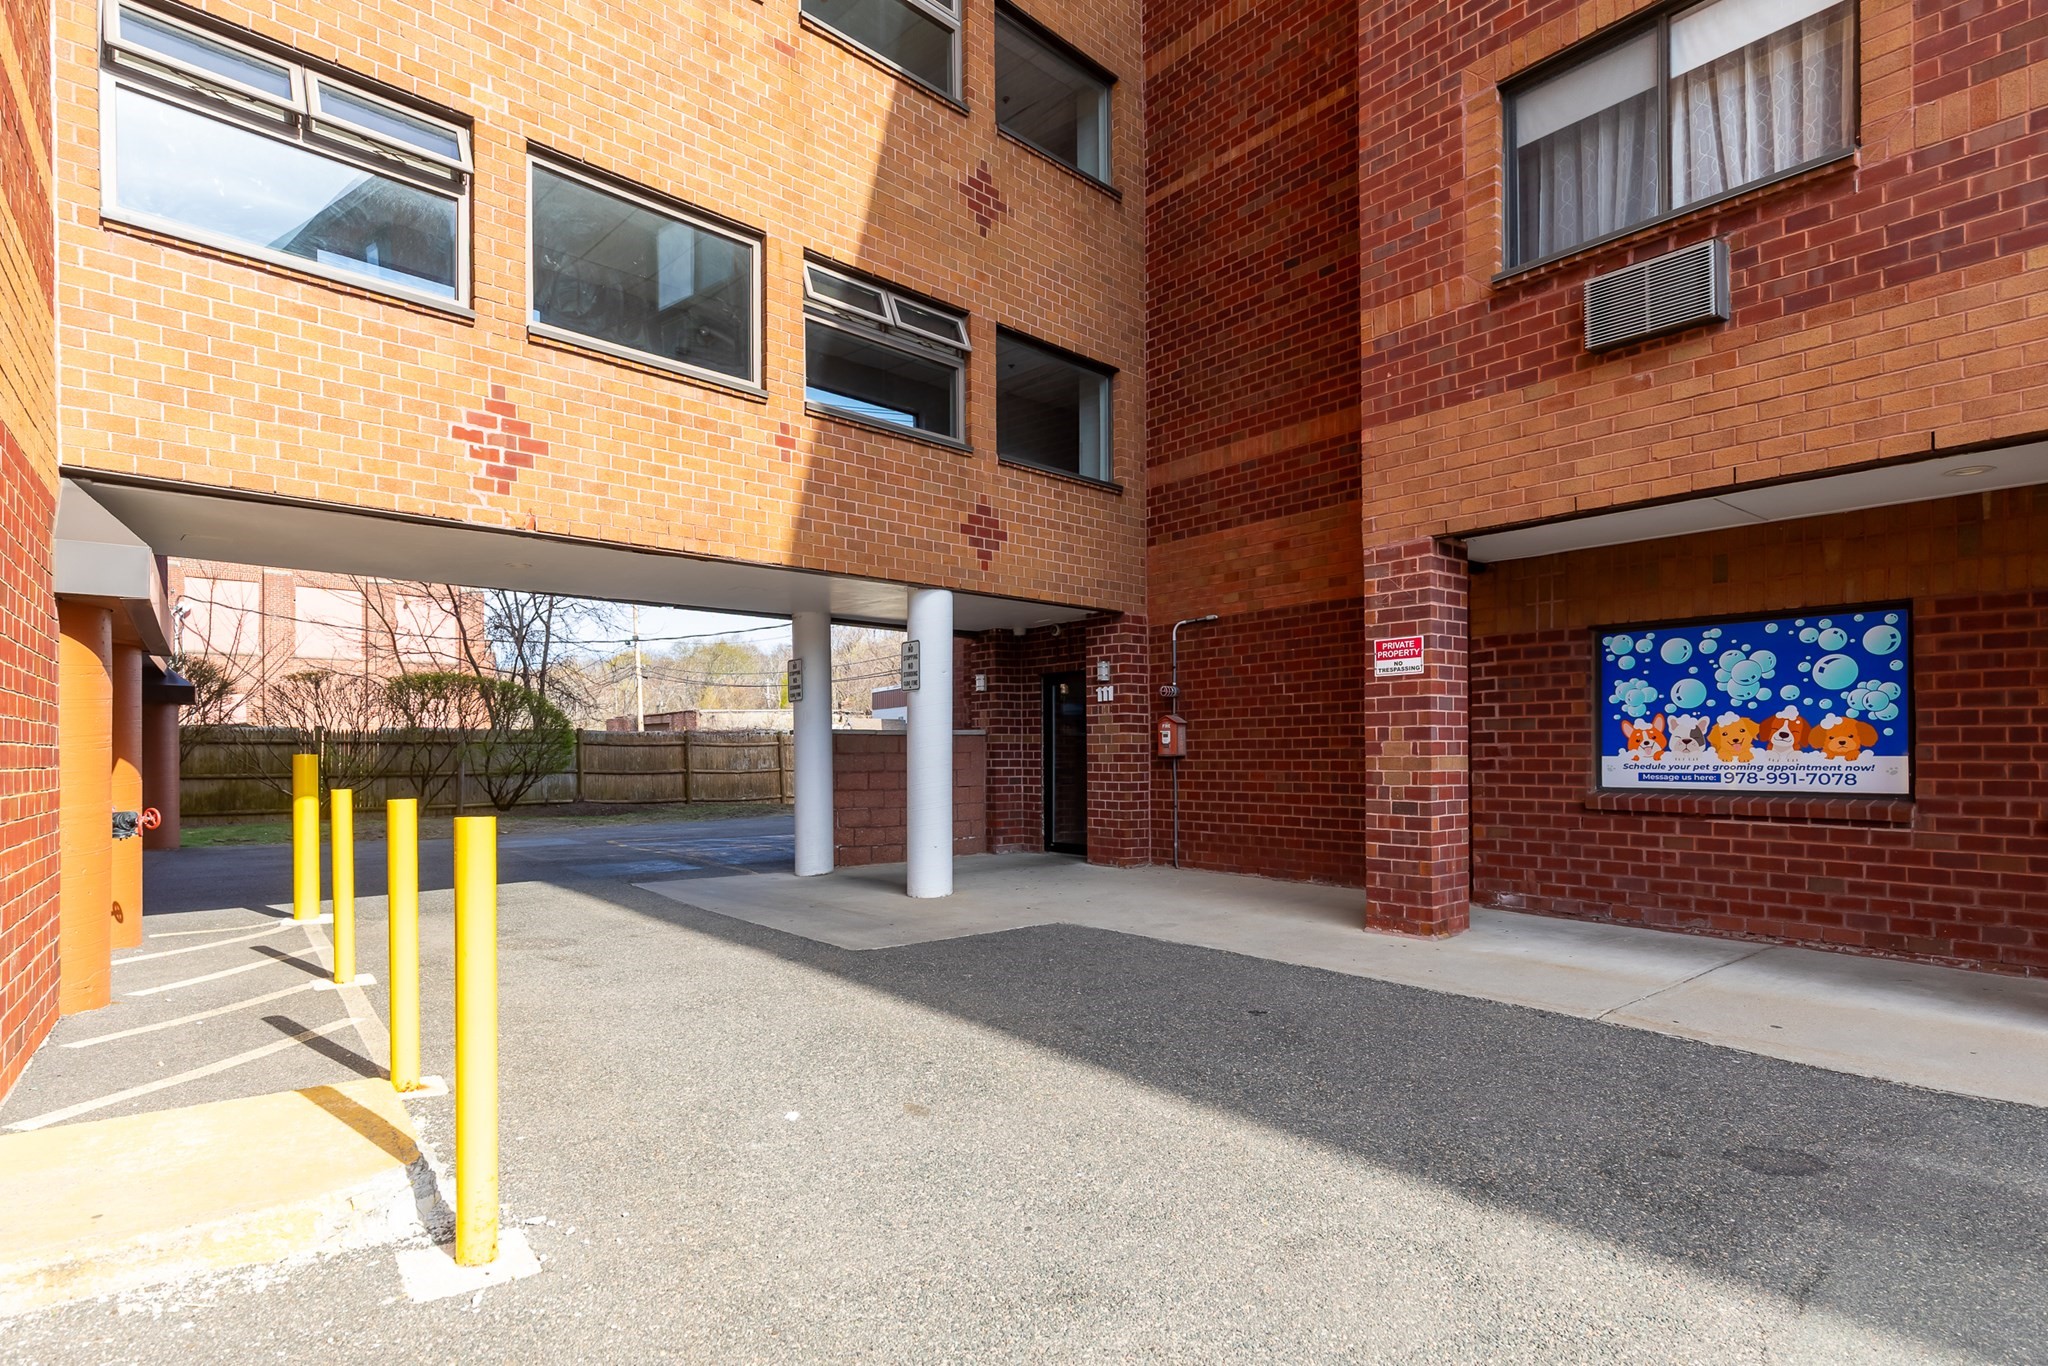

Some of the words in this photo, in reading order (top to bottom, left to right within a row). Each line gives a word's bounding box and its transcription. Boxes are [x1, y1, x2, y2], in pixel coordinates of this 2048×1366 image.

[1382, 640, 1415, 650] PRIVATE
[1378, 648, 1420, 658] PROPERTY
[1096, 685, 1114, 702] 111
[1622, 763, 1666, 771] Schedule
[1694, 764, 1711, 772] pet
[1712, 764, 1764, 772] grooming
[1766, 763, 1842, 772] appointment
[1693, 773, 1717, 781] here:
[1723, 772, 1857, 785] 978-991-7078
